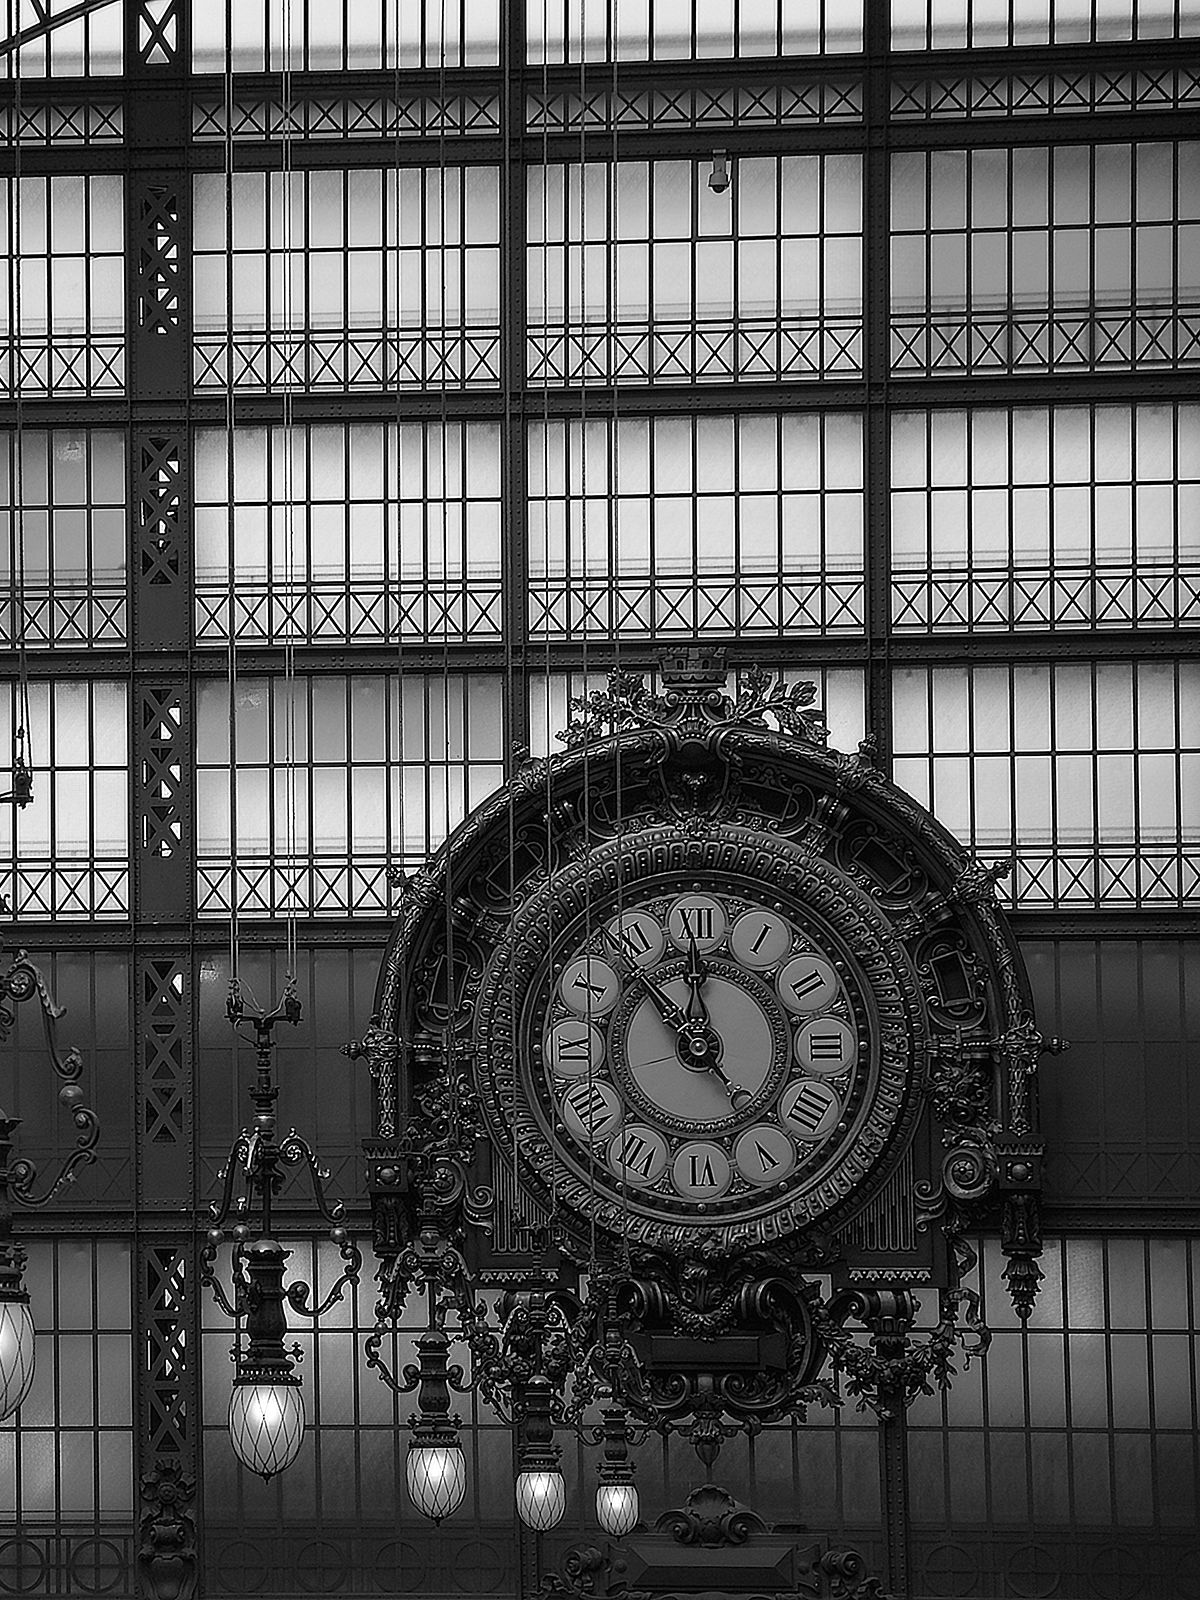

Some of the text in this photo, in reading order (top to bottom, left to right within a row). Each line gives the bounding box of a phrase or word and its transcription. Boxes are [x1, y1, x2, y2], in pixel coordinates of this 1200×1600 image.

[678, 908, 714, 939] XII
[750, 923, 772, 954] I
[616, 922, 653, 959] XI
[572, 973, 607, 1002] X
[790, 969, 826, 1001] II
[558, 1036, 591, 1061] IX
[810, 1033, 843, 1061] III
[569, 1084, 613, 1132] VIII
[787, 1086, 832, 1132] IIII
[616, 1134, 657, 1178] VII
[689, 1155, 717, 1186] VI
[755, 1141, 779, 1172] V
